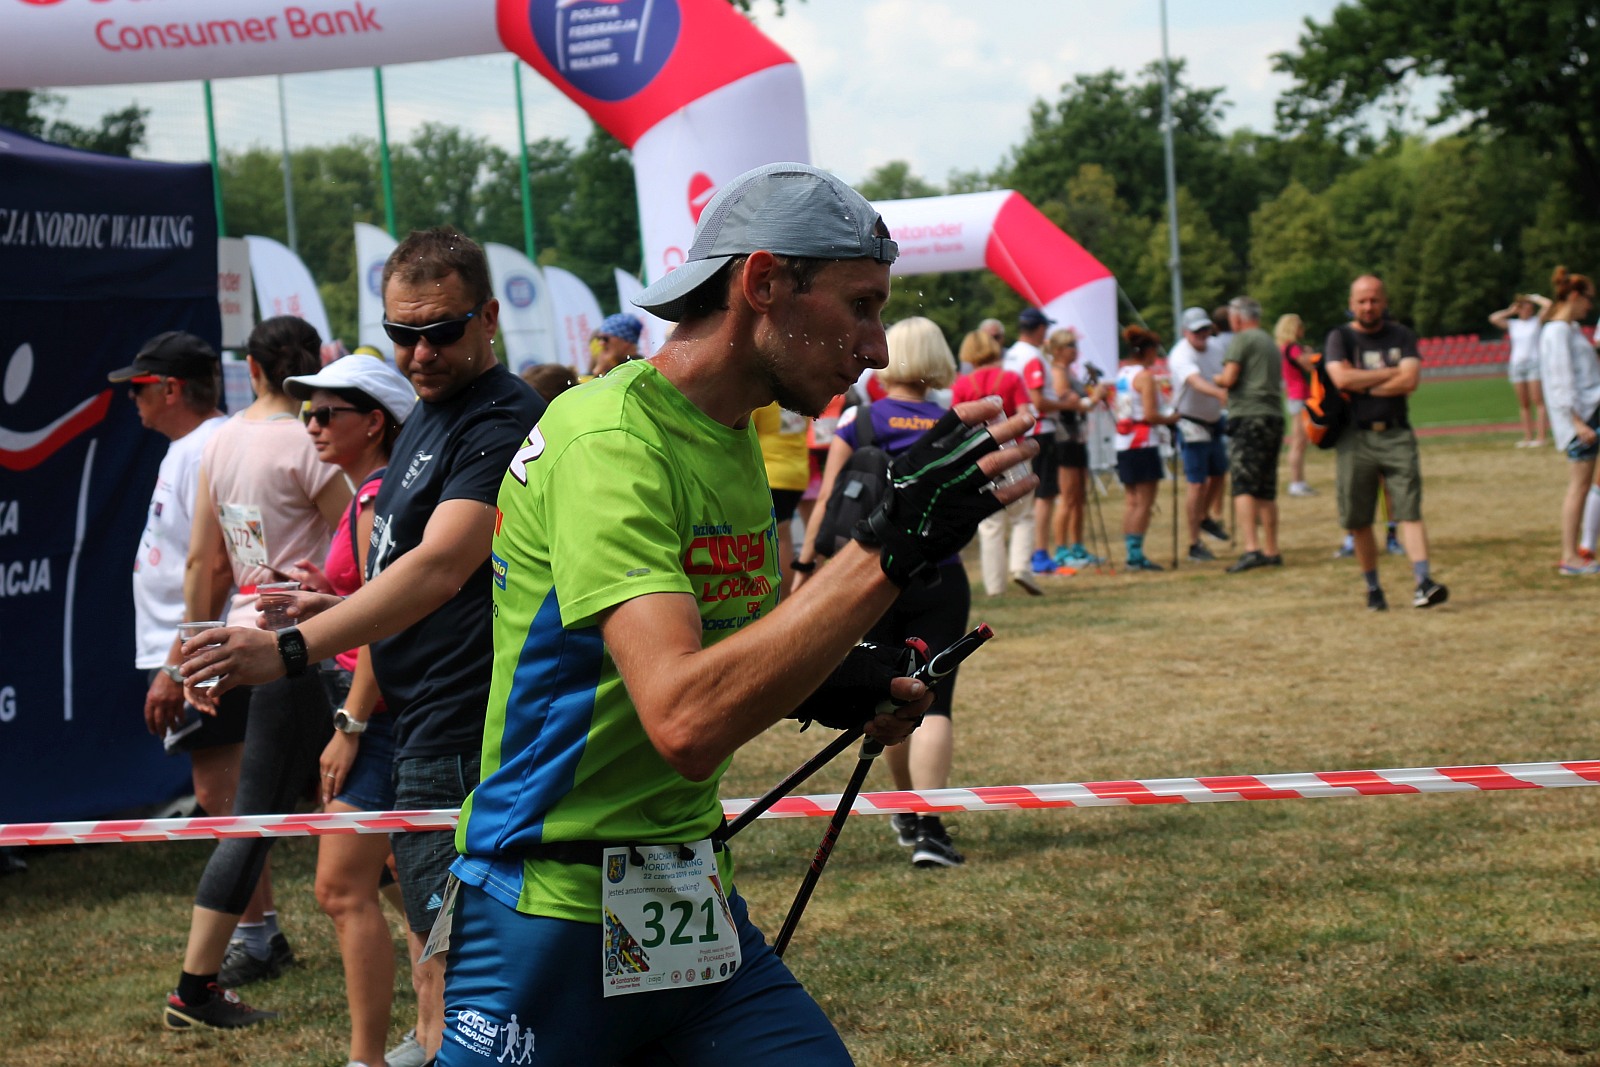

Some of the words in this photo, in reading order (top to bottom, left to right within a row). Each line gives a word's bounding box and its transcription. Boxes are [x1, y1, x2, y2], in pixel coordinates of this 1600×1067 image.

[95, 16, 279, 52] Consumer
[284, 2, 382, 38] Bank
[30, 211, 108, 248] NORDIC
[110, 214, 193, 248] WALKING
[890, 222, 963, 240] ntander
[888, 415, 940, 430] GRAŻYN
[648, 851, 672, 861] PUCHAR
[641, 863, 670, 871] NORDIC
[671, 858, 703, 869] WALKING
[653, 872, 676, 880] czerwca
[625, 887, 656, 896] amatorem
[641, 897, 719, 948] 321
